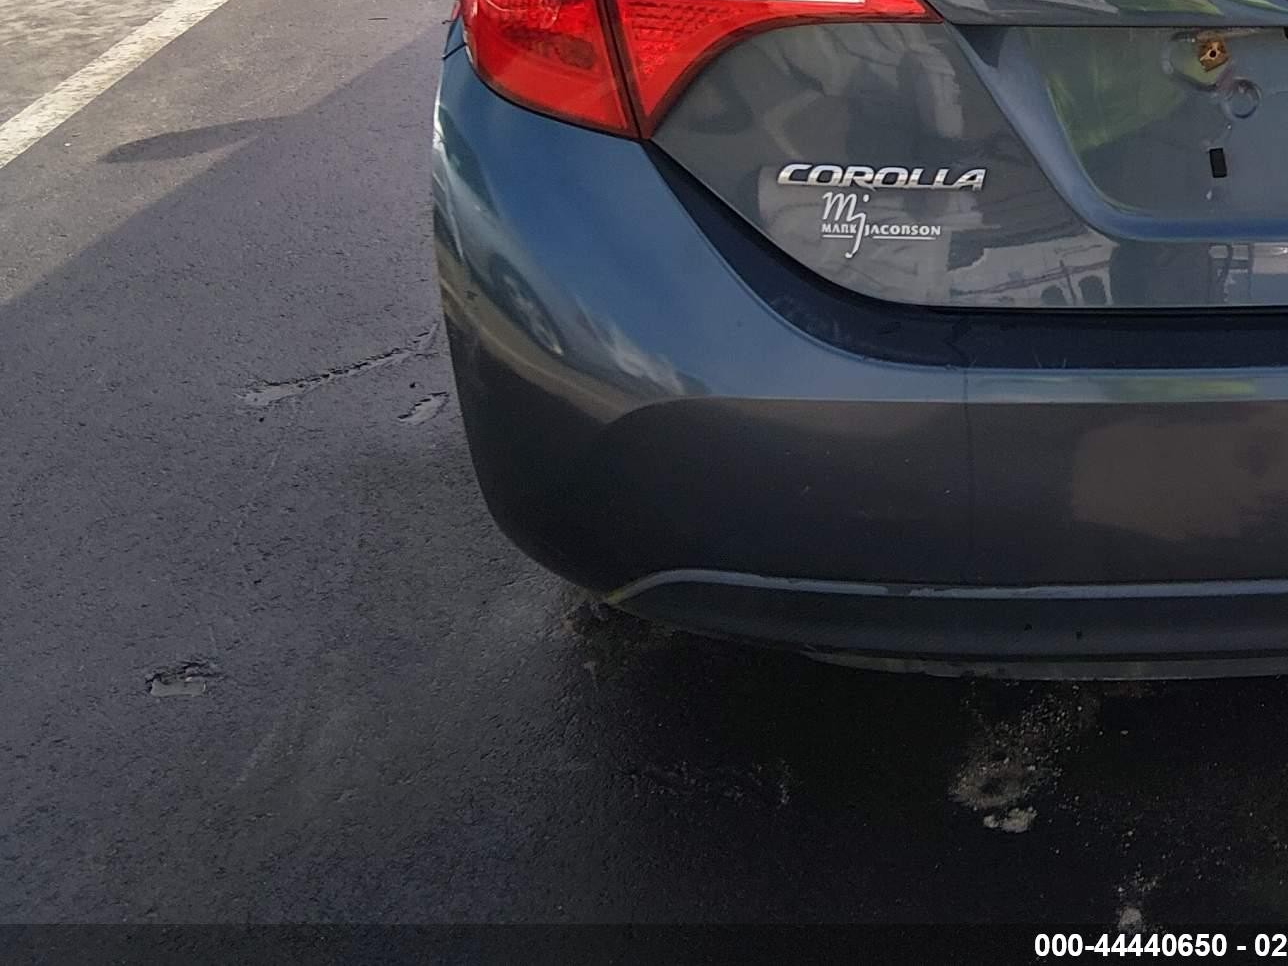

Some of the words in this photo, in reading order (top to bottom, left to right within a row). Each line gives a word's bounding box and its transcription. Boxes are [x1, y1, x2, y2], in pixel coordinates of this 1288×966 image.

[777, 163, 987, 192] COROLLA
[820, 223, 858, 235] MARK
[863, 223, 942, 237] JACOBSON
